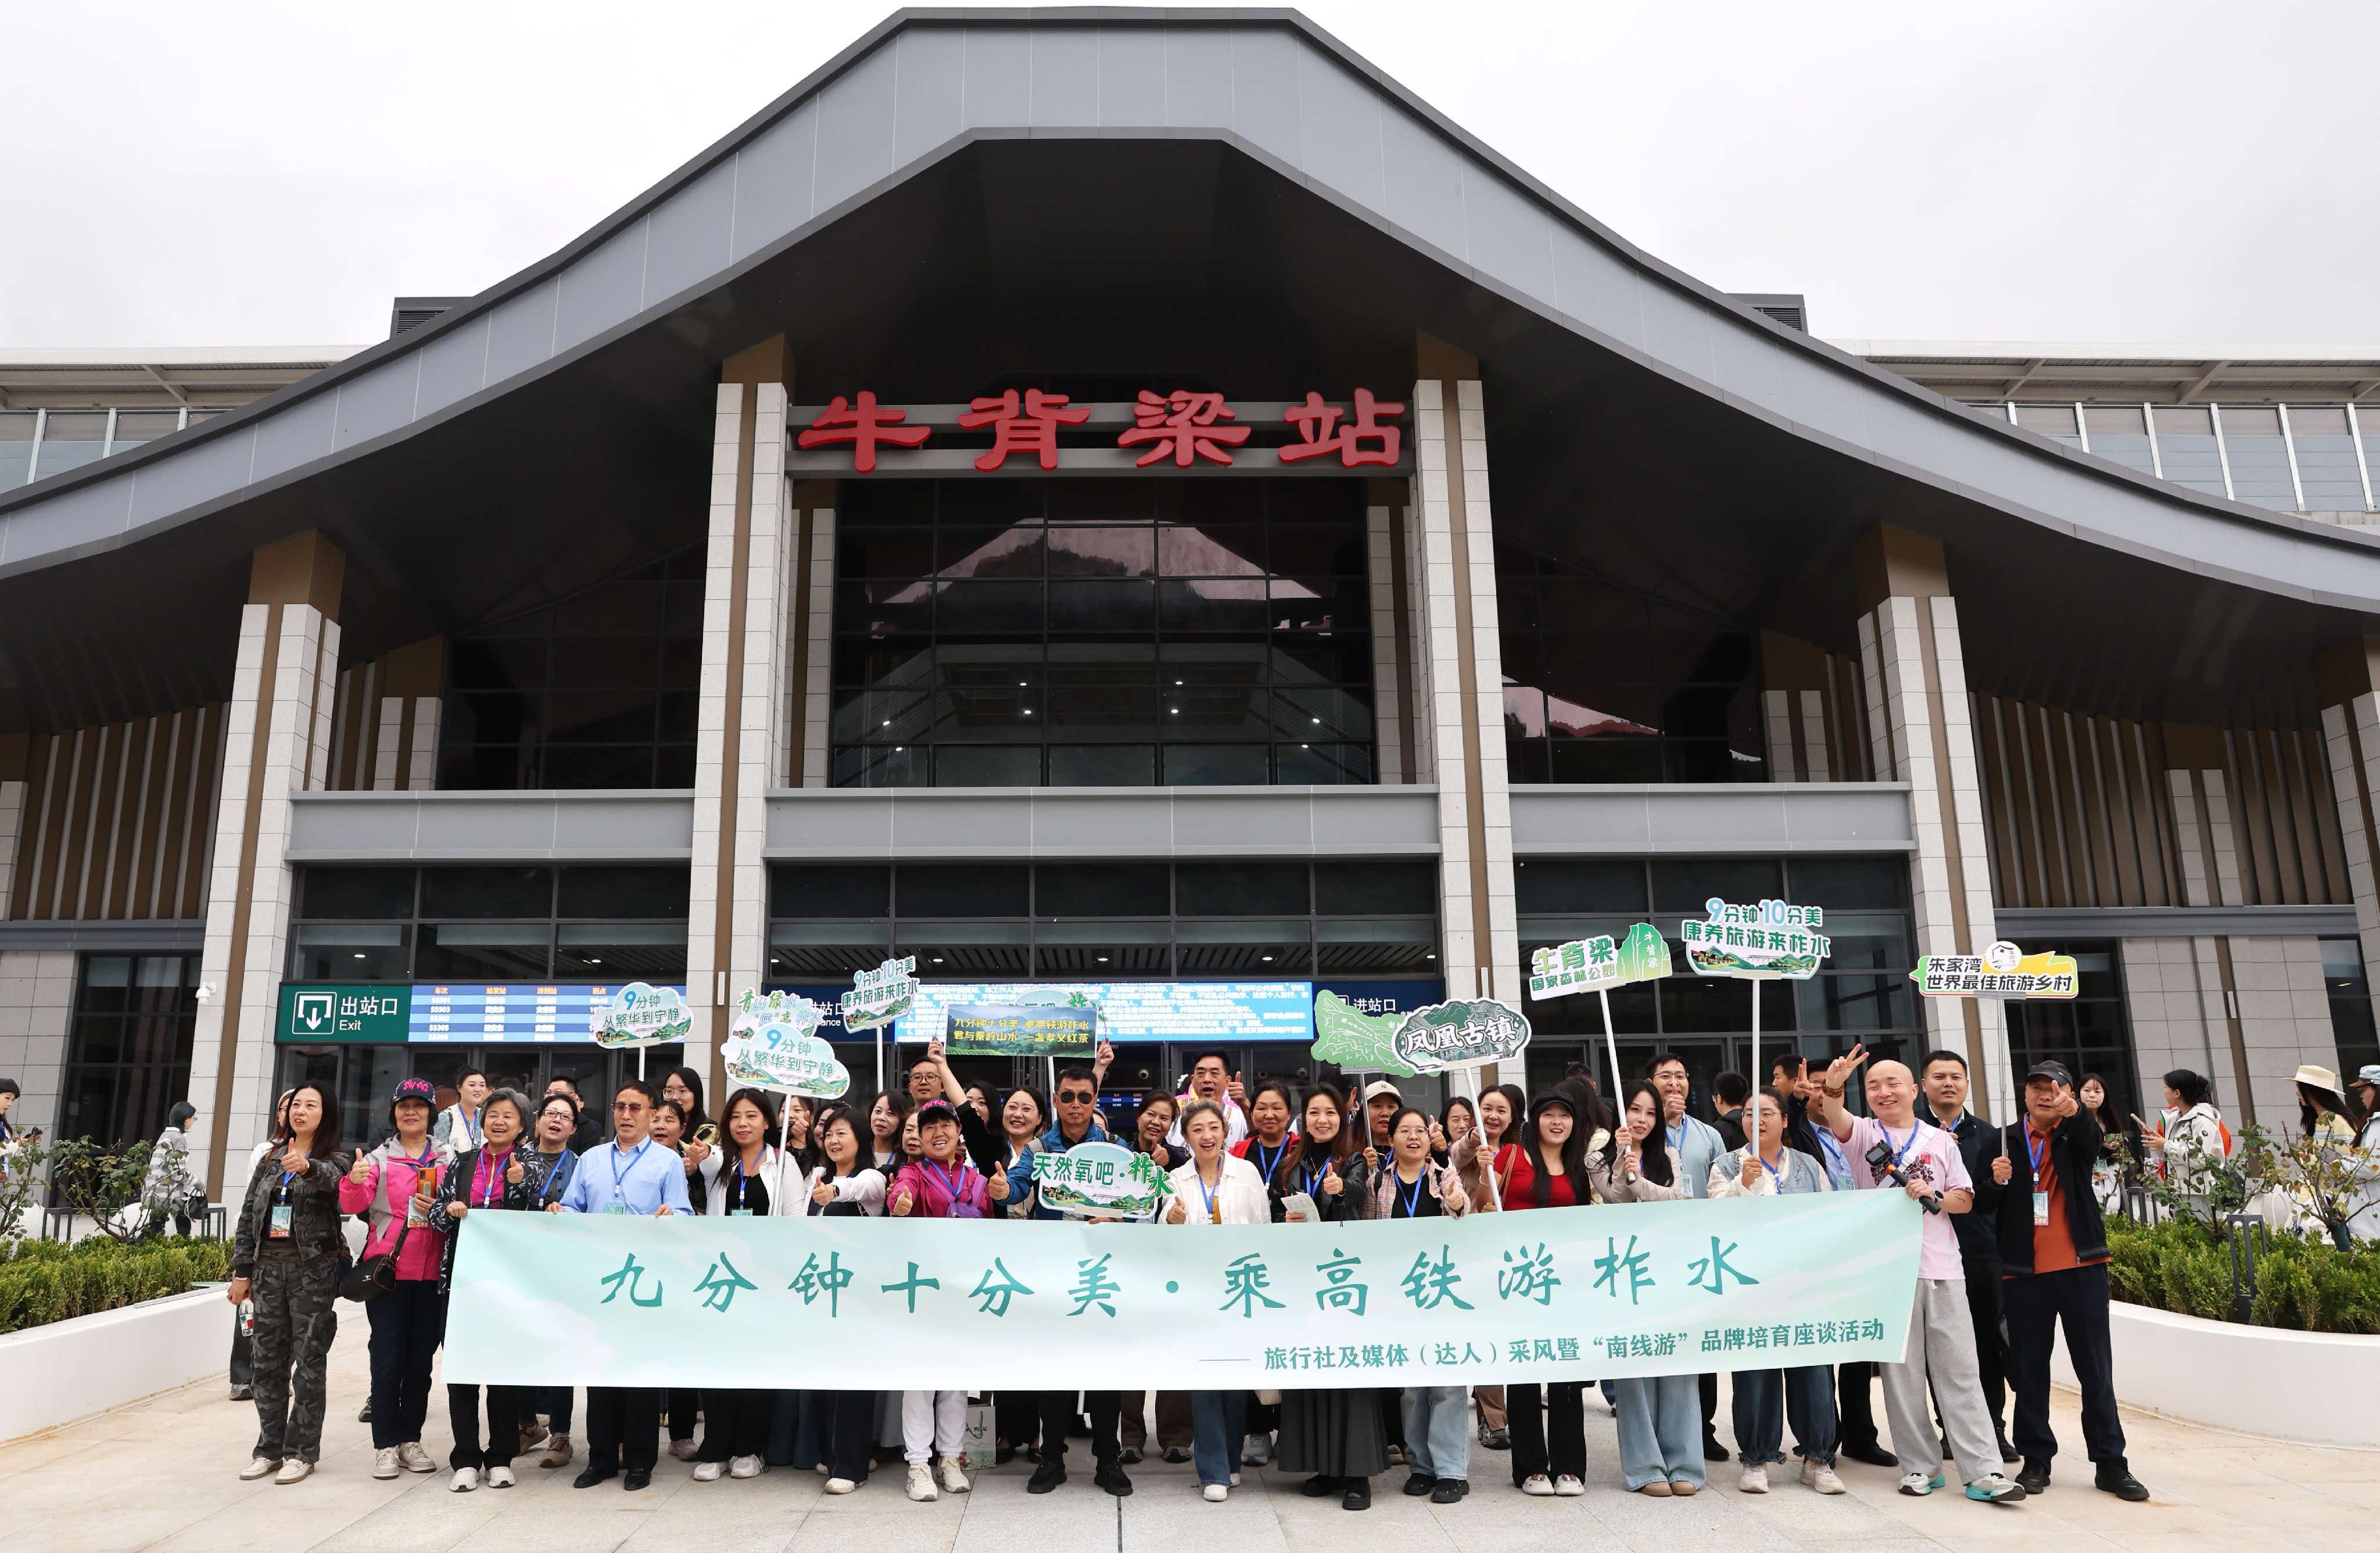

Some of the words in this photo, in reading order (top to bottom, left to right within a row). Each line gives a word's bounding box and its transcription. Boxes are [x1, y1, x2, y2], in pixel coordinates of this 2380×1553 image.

[798, 389, 1404, 473] 牛背梁站
[1708, 899, 1821, 924] 9分钟10分美
[1684, 921, 1829, 956] 康养旅游来柞水
[1533, 937, 1614, 975] 牛背梁
[1928, 957, 1982, 973] 朱家湾
[855, 959, 913, 989] 9分钟10分美
[1531, 964, 1614, 991] 国家森林公园
[1927, 975, 2072, 991] 世界最佳旅游乡村
[340, 996, 398, 1016] 出站口
[624, 991, 661, 1010] 9分钟
[843, 979, 918, 1009] 康养旅游来柞水
[1353, 998, 1396, 1012] 进站口
[339, 1020, 361, 1031] Exit
[603, 1009, 680, 1028] 从繁华到宁静
[766, 1029, 811, 1056] 9分钟
[1405, 1016, 1517, 1055] 凤凰古镇
[737, 1048, 835, 1077] 从繁华到宁静
[1032, 1153, 1174, 1197] 天然氧吧·柞水
